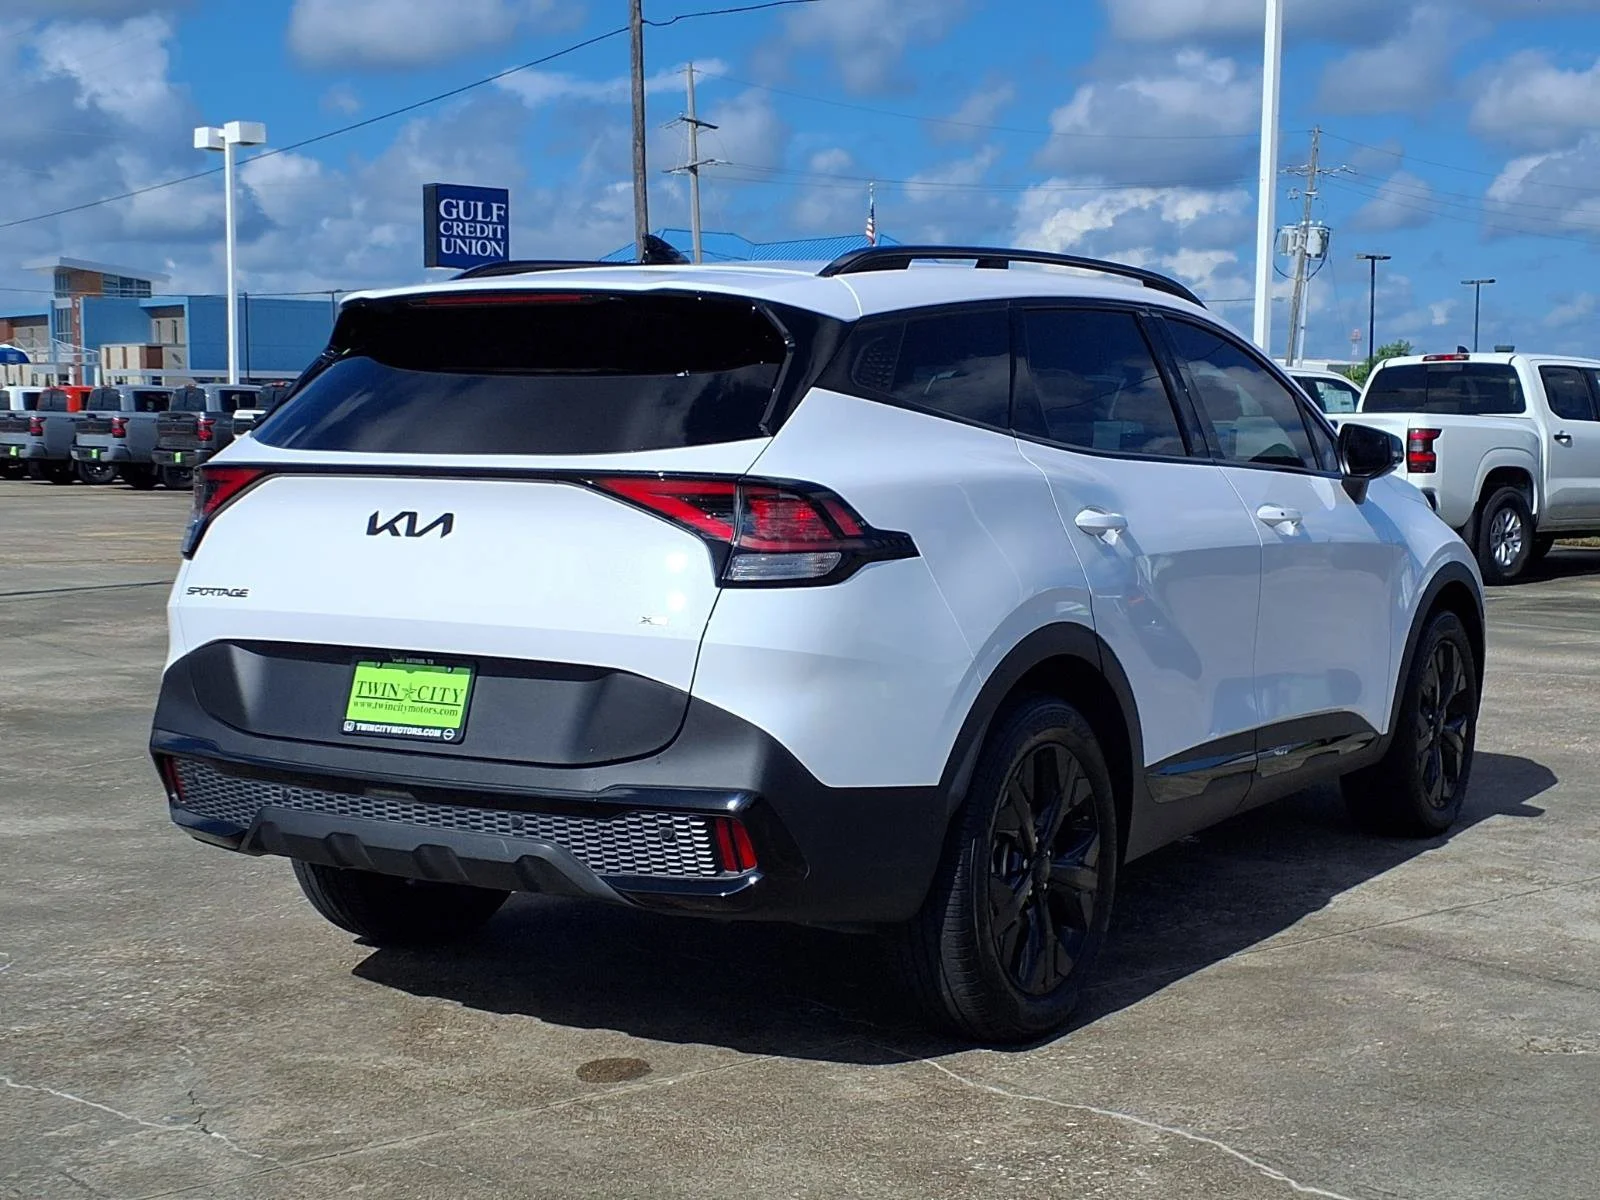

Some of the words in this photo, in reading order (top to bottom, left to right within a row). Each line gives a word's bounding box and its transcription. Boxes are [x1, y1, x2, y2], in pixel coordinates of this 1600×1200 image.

[439, 198, 506, 222] GULF
[439, 220, 505, 239] CREDIT
[440, 237, 504, 257] UNION
[366, 510, 454, 538] KIA
[186, 587, 249, 598] SPORTAGE
[356, 680, 400, 698] TWIN
[417, 685, 464, 703] CITY
[353, 700, 458, 717] www.twincitymotors.com
[356, 722, 441, 737] TWINCITYMOTORS.COM
